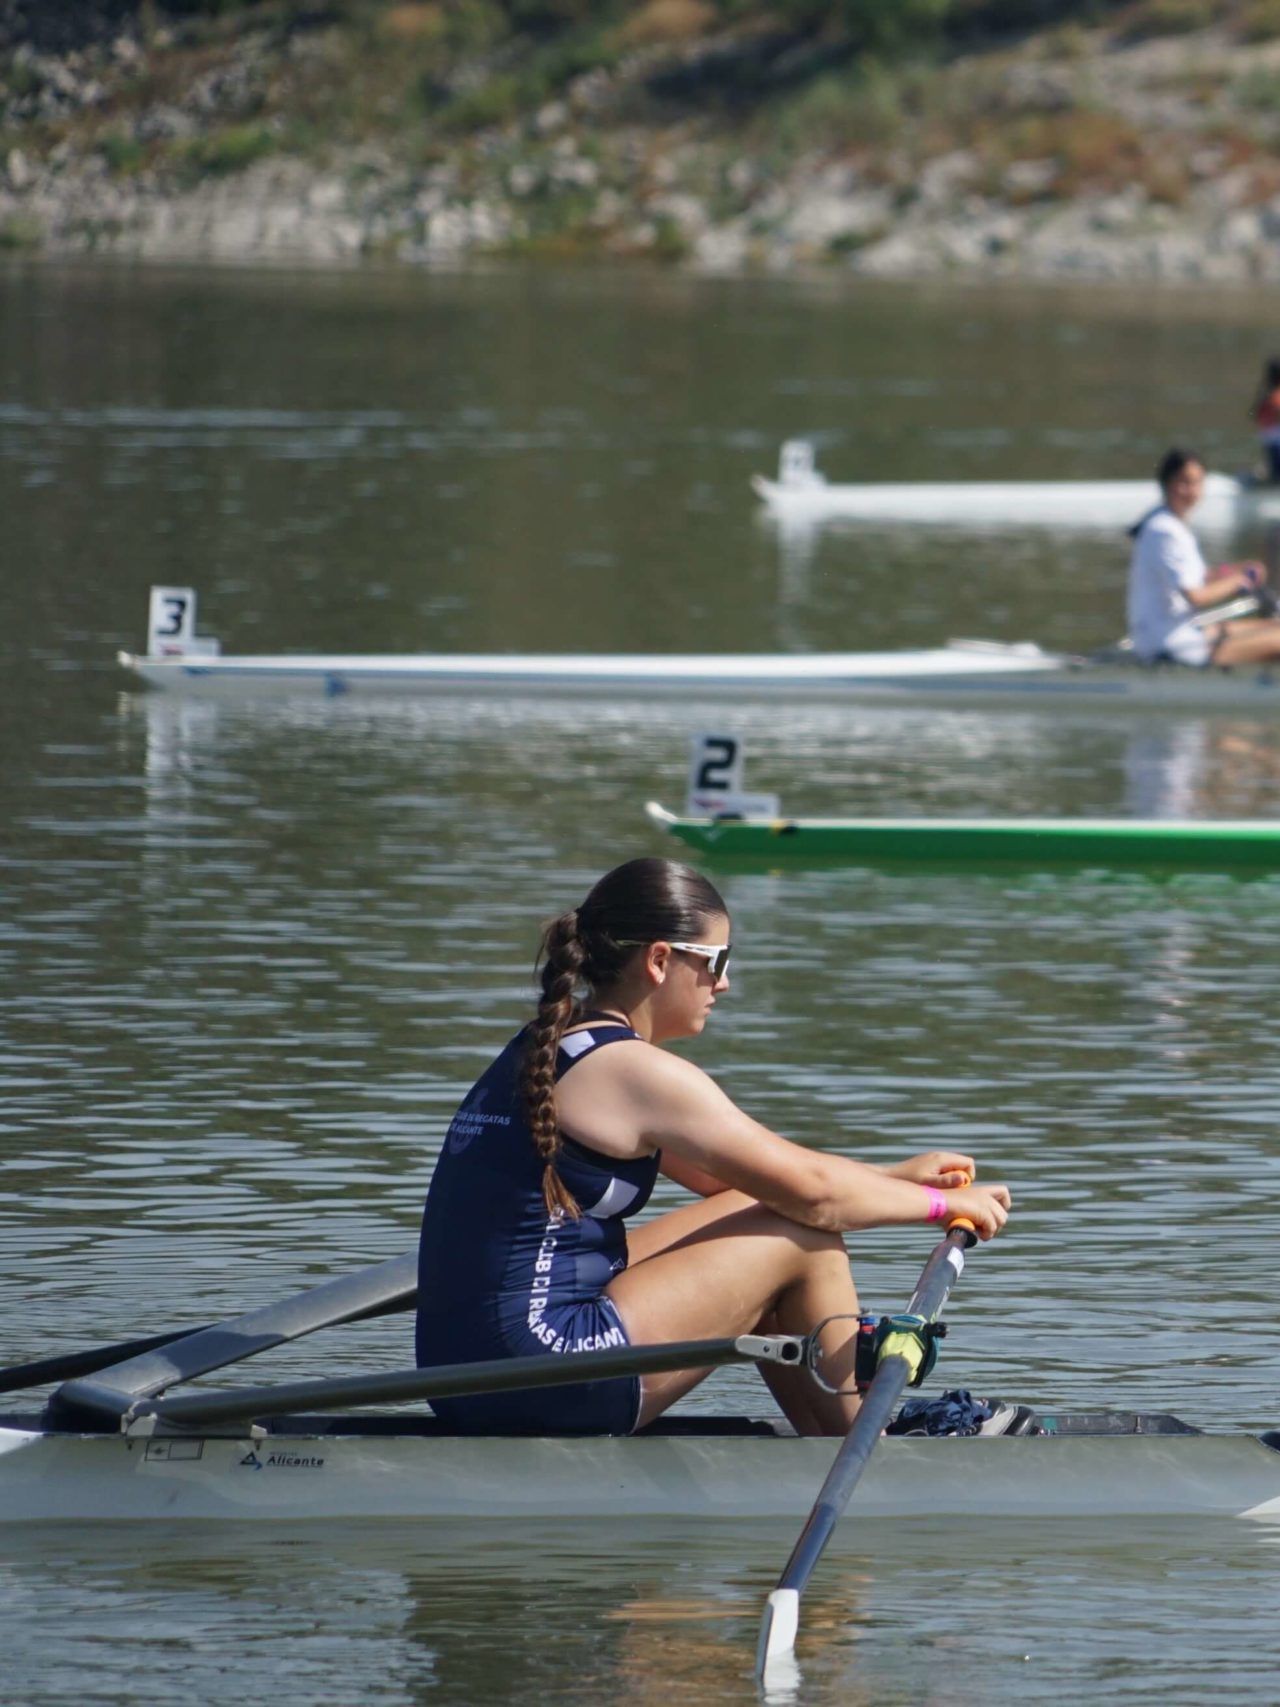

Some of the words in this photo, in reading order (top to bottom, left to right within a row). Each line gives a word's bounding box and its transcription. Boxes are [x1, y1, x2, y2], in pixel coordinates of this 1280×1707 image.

[157, 598, 186, 635] 3
[697, 738, 737, 790] 2
[266, 1455, 325, 1467] Alicante
